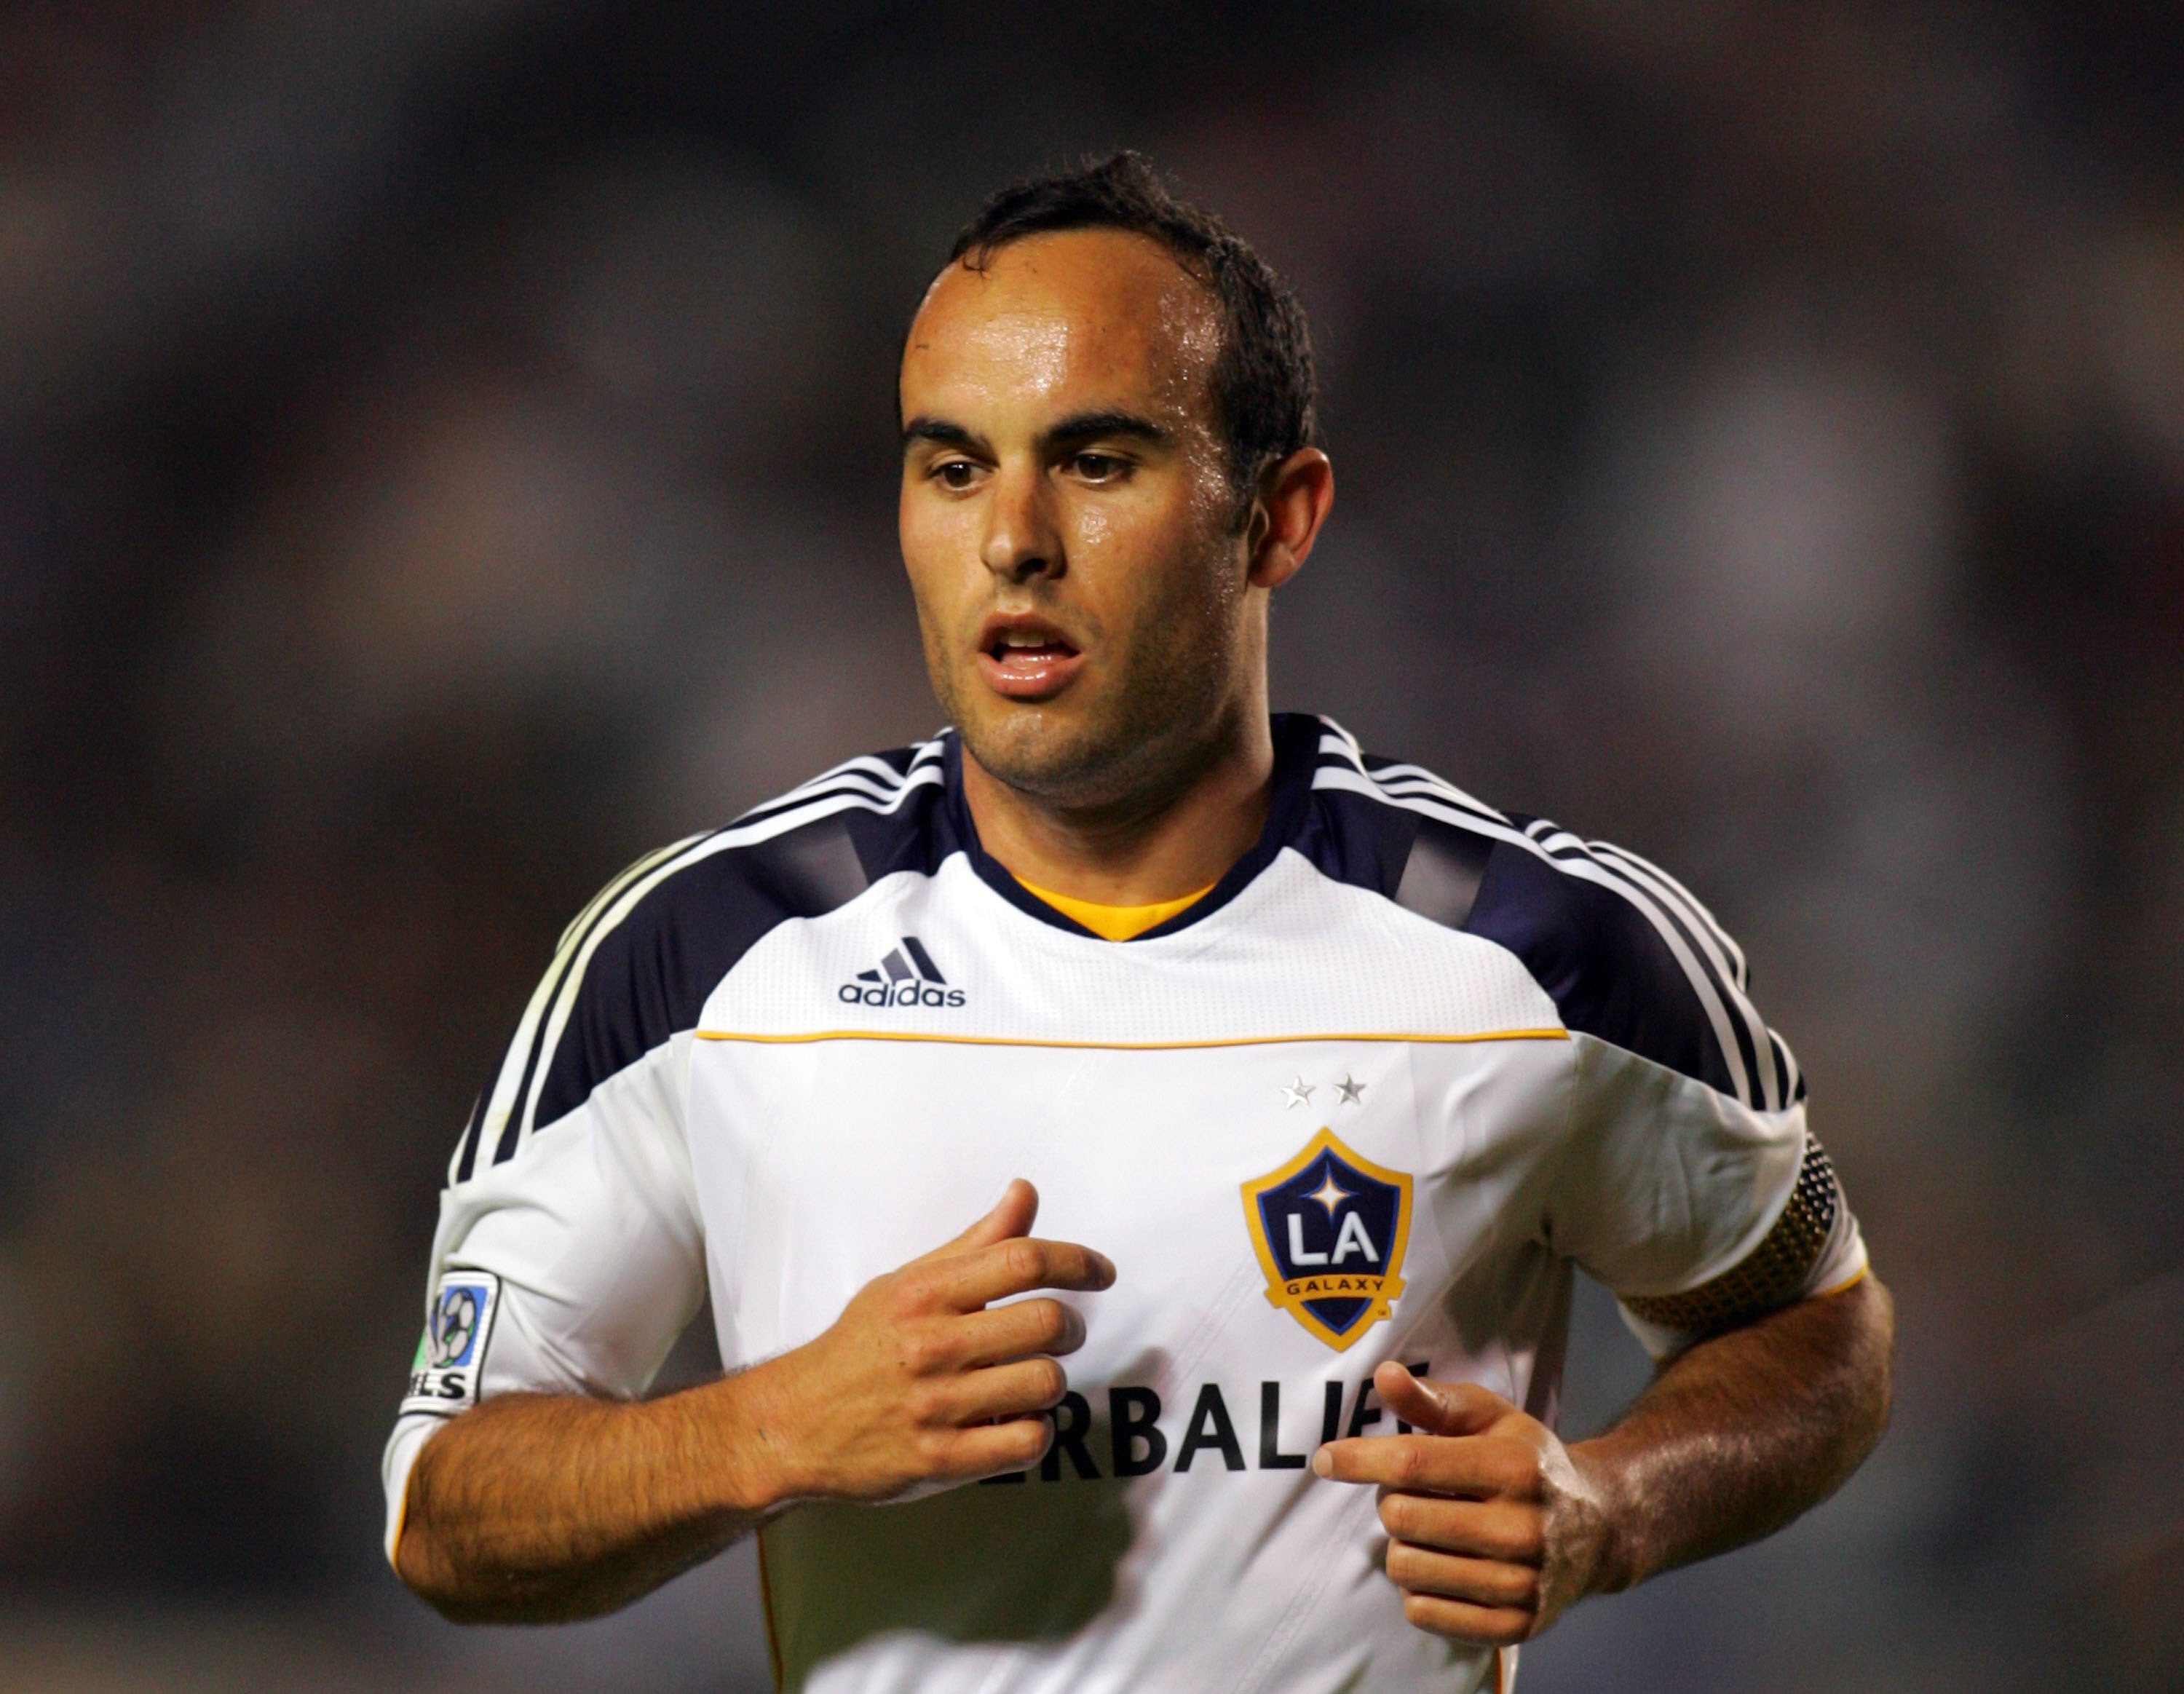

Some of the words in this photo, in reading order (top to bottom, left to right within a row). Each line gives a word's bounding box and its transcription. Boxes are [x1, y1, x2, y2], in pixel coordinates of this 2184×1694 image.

[839, 980, 966, 1008] adidas
[1286, 1211, 1380, 1266] LA
[1286, 1279, 1385, 1296] GALAXY
[979, 1361, 1431, 1484] RBALIF
